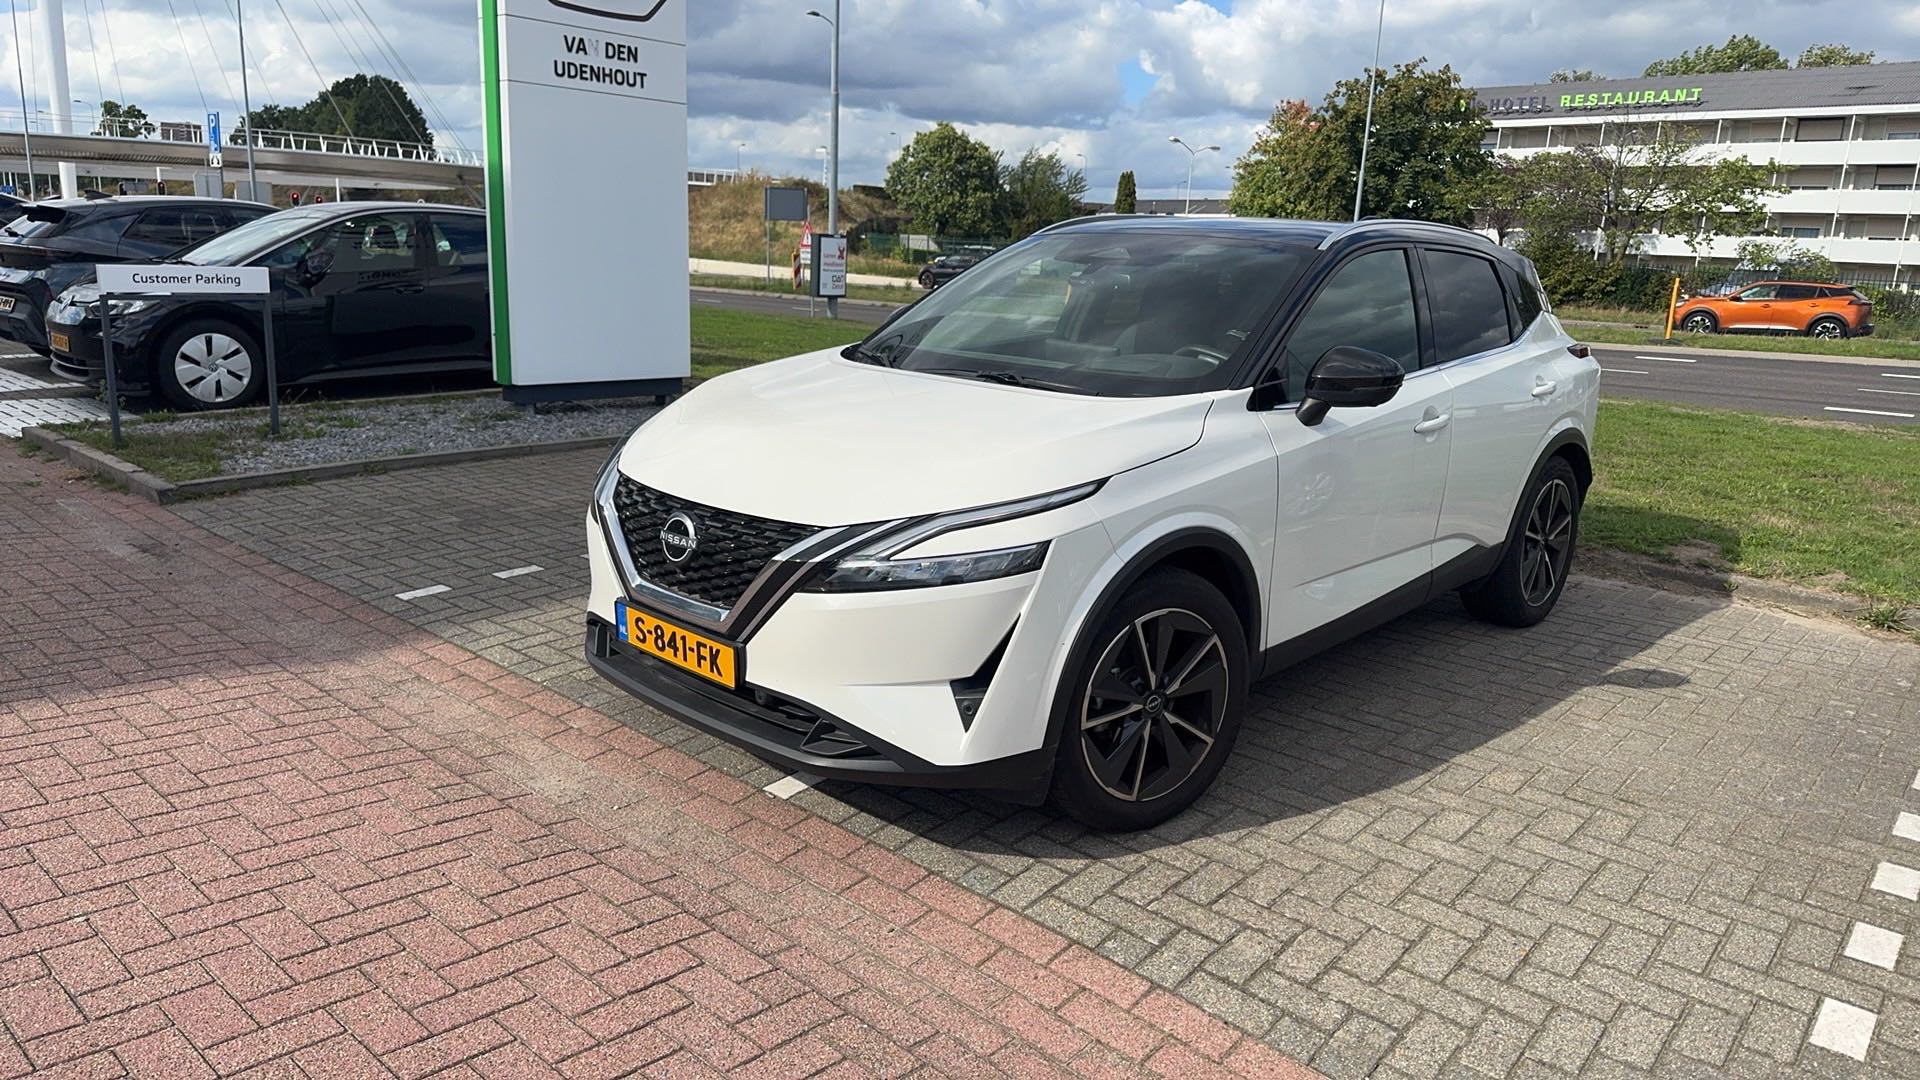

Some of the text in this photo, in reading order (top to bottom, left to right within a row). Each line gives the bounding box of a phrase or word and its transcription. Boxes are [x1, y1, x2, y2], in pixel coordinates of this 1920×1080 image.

[605, 41, 638, 63] DEN
[554, 59, 647, 89] UDENHOUT
[1489, 96, 1553, 113] HOTEL
[1560, 87, 1702, 107] RESTAURANT
[132, 272, 241, 287] Customer Parking
[660, 530, 697, 548] NISSAN
[634, 616, 723, 678] S-841-FK
